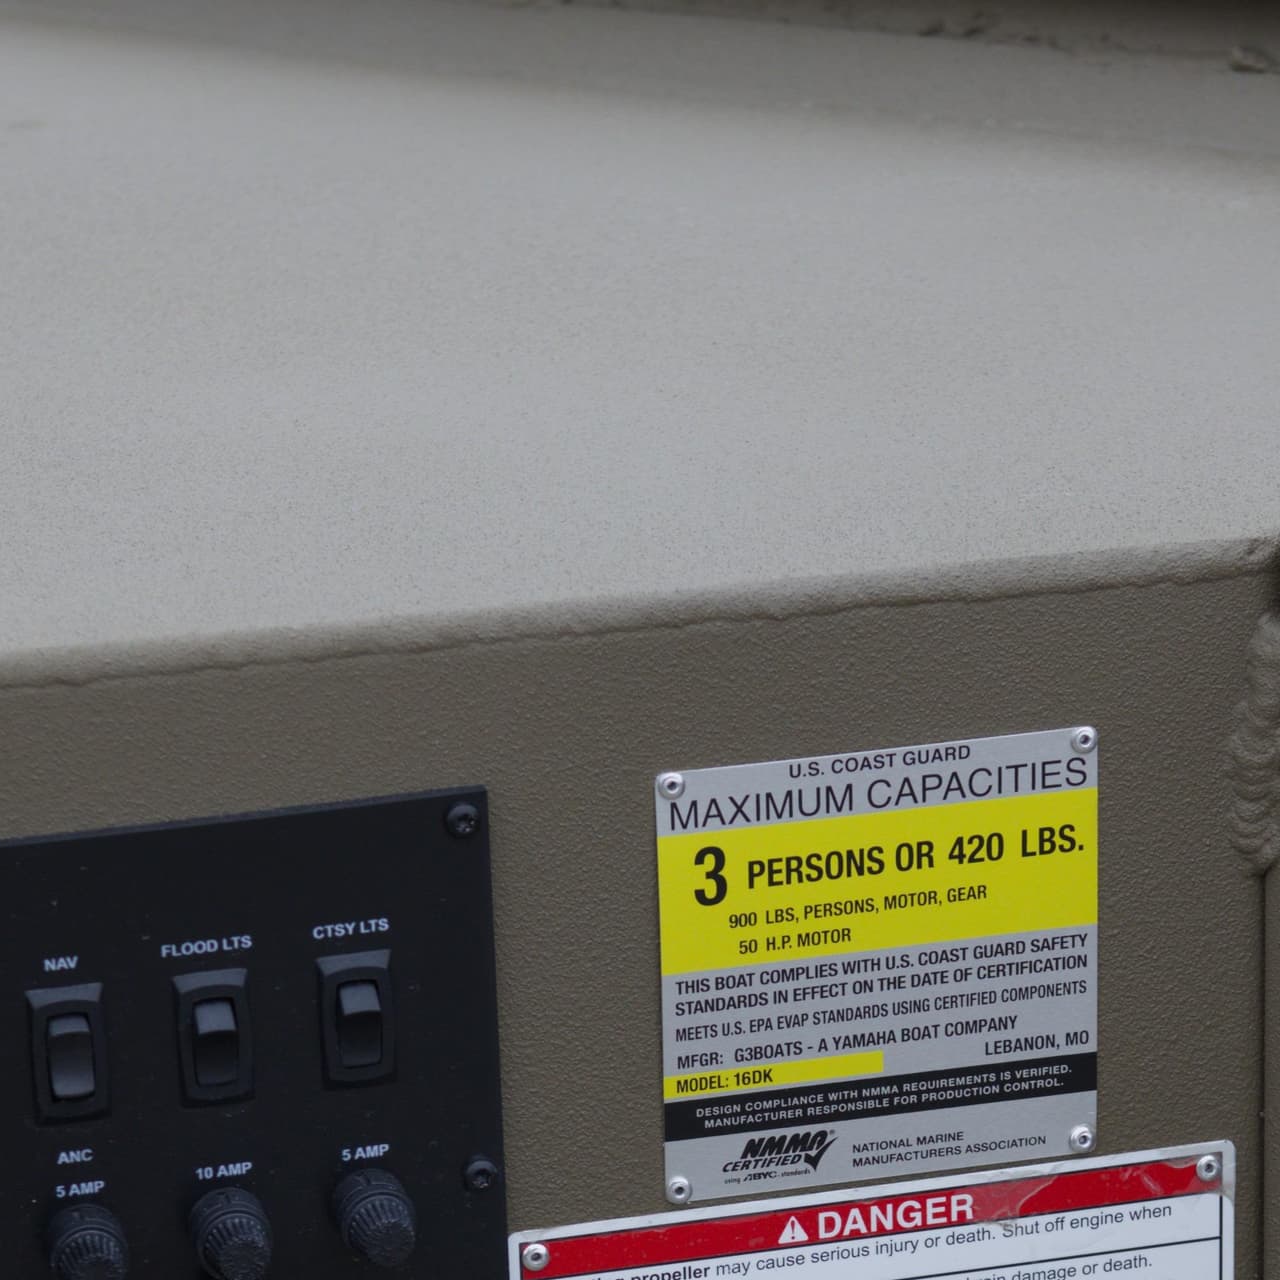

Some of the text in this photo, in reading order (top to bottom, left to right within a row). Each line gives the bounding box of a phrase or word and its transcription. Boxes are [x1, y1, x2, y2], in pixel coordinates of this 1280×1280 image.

[789, 745, 971, 779] U.S. COAST GUARD
[670, 756, 1087, 831] MAXIMUM CAPACITIES
[694, 823, 1084, 907] 3 PERSONS OR 420 LBS.
[728, 884, 987, 929] 900 LBS, PERSONS, MOTOR, GEAR
[312, 916, 391, 940] CTSY LTS
[739, 927, 851, 955] 50 H.P. MOTOR
[160, 934, 253, 959] FLOOD LTS
[43, 955, 79, 972] NAV
[675, 932, 1088, 996] THIS BOAT COMPLIES WITH U.S. COAST GUARD SAFETY
[675, 954, 1088, 1017] STANDARDS IN EFFECT ON THE DATE OF CERTIFICATION
[675, 979, 1087, 1043] MEETS U.S. EPA EVAP STANDARDS USING CERTIFIED COMPONENTS
[677, 1015, 1018, 1070] MFGR: G3BOATS A YAMAHA BOAT COMPANY
[985, 1029, 1089, 1056] LEBANON, MO
[676, 1068, 773, 1094] MODEL: 16DK
[696, 1064, 1072, 1118] DESIGN COMPLIANCE WITH NMMA REQUIREMENTS IS VERIFIED.
[704, 1077, 1064, 1129] MANUFACTURER RESPONSIBLE FOR PRODUCTION CONTROL.
[56, 1148, 94, 1165] ANC
[341, 1143, 390, 1162] 5 AMP
[740, 1129, 829, 1160] NMMA
[852, 1131, 964, 1153] NATIONAL MARINE
[852, 1135, 1046, 1168] MANUFACTURERS ASSOCIATION
[195, 1161, 253, 1181] 10 AMP
[722, 1153, 803, 1173] CERTIFIED
[55, 1180, 106, 1199] 5 AMP
[818, 1193, 974, 1239] DANGER
[716, 1261, 751, 1276] may
[756, 1254, 805, 1271] cause
[810, 1246, 870, 1264] serious
[875, 1239, 919, 1257] injury
[924, 1236, 941, 1249] or
[945, 1227, 996, 1246] death.
[999, 1220, 1040, 1238] Shut
[1044, 1216, 1066, 1233] off
[1070, 1211, 1124, 1230] engine
[1128, 1205, 1172, 1221] when
[1082, 1263, 1099, 1276] or
[1103, 1254, 1152, 1273] death.
